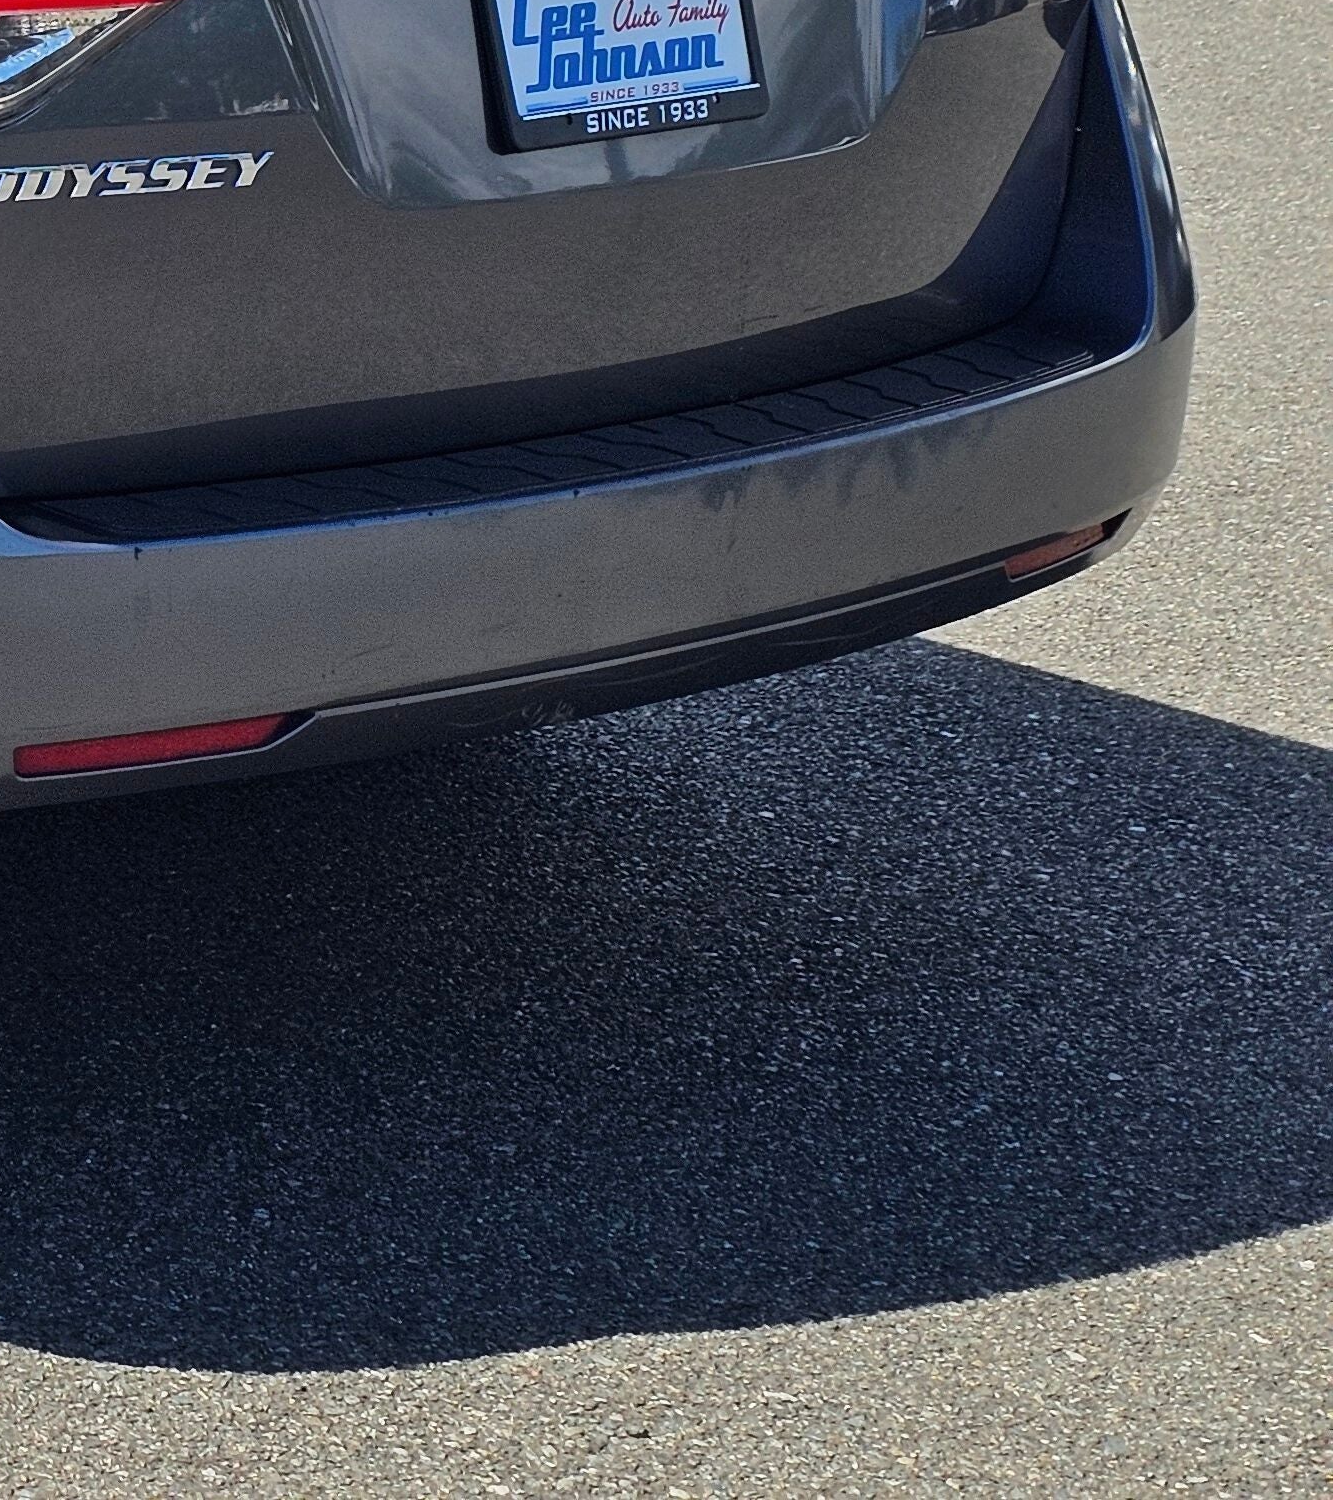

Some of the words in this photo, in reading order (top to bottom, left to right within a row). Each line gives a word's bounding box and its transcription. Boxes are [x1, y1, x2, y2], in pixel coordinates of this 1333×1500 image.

[526, 25, 724, 94] Johnson
[590, 86, 636, 103] SINCE
[643, 81, 680, 96] 1933
[586, 106, 650, 134] SINCE
[658, 98, 709, 124] 1933
